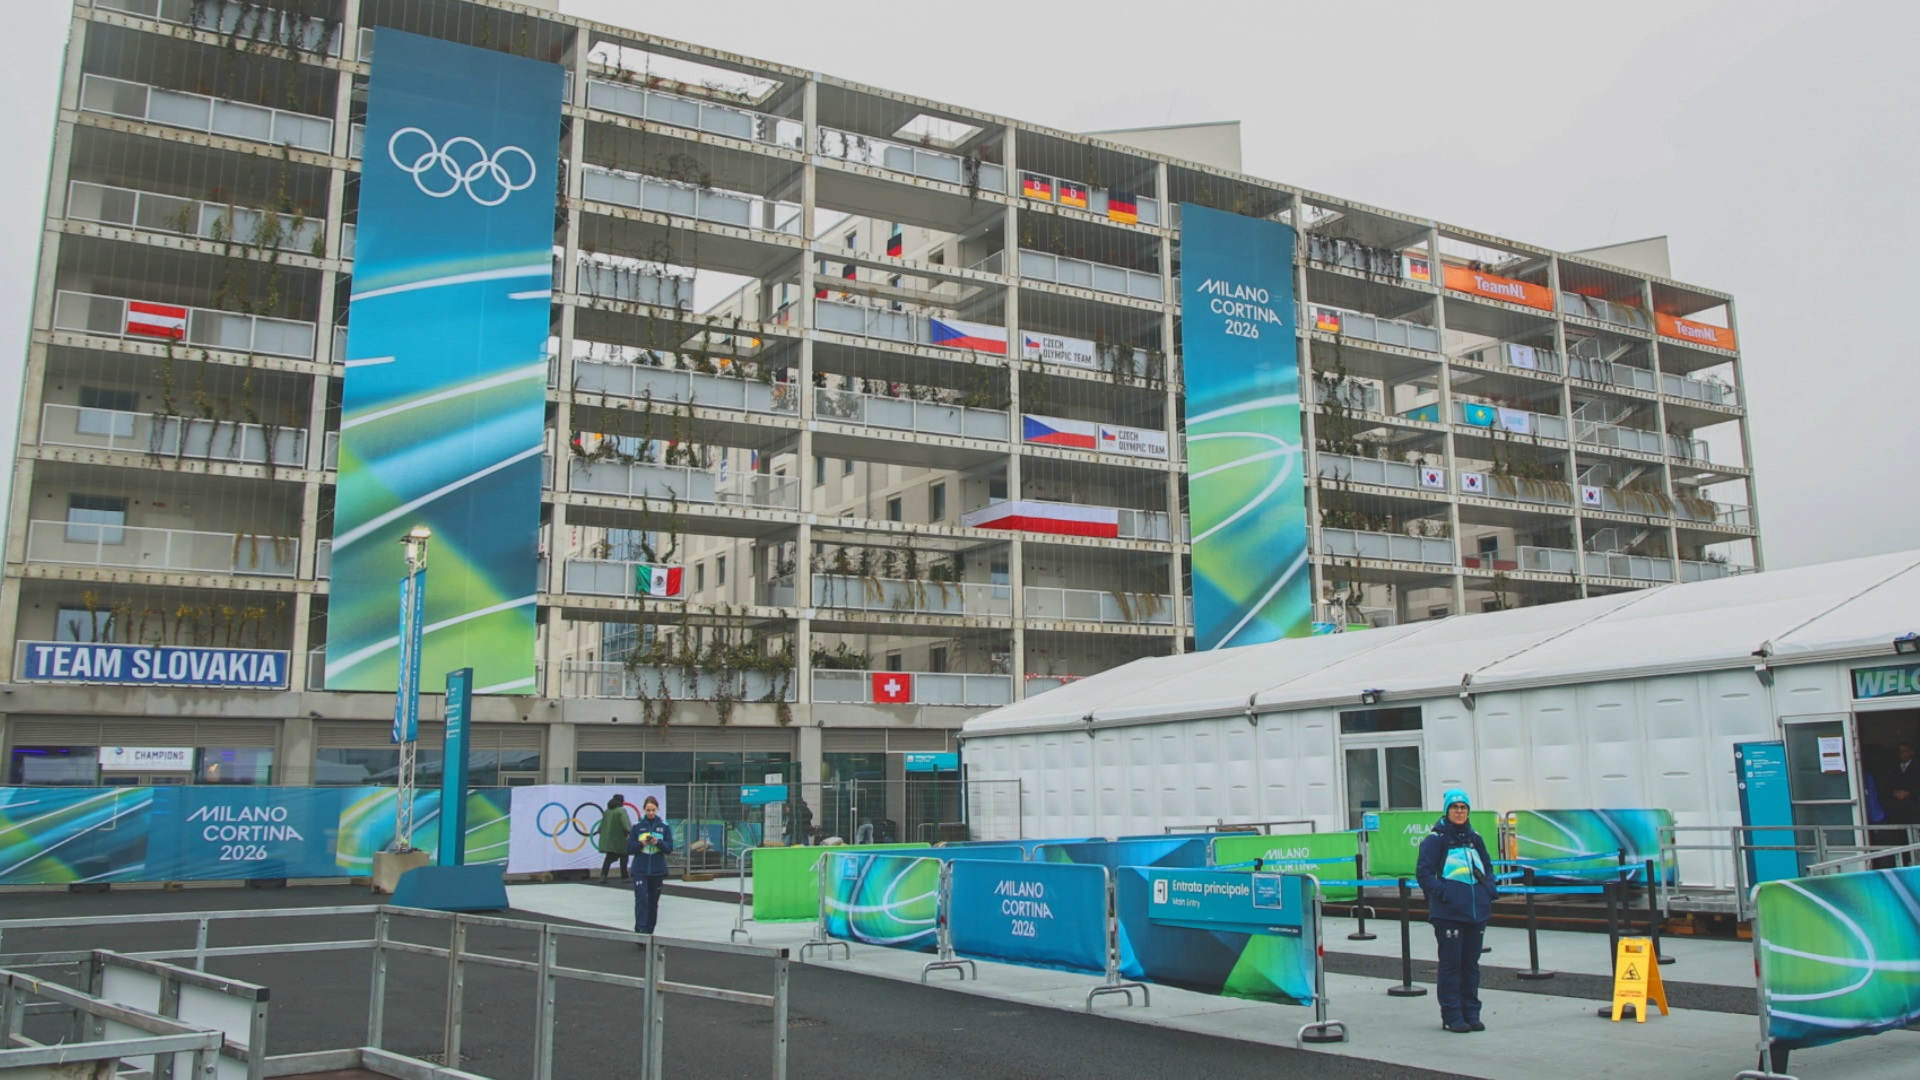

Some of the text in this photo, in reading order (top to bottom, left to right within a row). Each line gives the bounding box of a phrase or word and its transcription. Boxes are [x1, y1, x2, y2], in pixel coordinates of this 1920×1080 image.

[1197, 278, 1269, 304] MILANO
[1474, 275, 1527, 299] TeamNL
[1210, 298, 1282, 326] CORTINA
[1225, 319, 1259, 339] 2026
[1674, 320, 1718, 342] TeamNL
[1043, 337, 1064, 349] CZECH
[1043, 348, 1092, 364] OLYMPIC TEAM
[1118, 430, 1139, 441] CZECH
[1118, 441, 1165, 455] OLYMPIC TEAM
[35, 646, 277, 683] TEAM SLOVAKIA
[134, 750, 185, 760] CHAMPIONS
[186, 805, 288, 822] MILANO
[203, 825, 304, 841] CORTINA
[1403, 823, 1434, 834] MILA
[219, 844, 268, 861] 2026
[1262, 847, 1310, 860] MILANO
[993, 879, 1044, 898] MILANO
[1172, 880, 1203, 893] Entrata
[1204, 881, 1250, 899] principale
[1002, 899, 1054, 920] CORTINA
[1011, 919, 1035, 937] 2026
